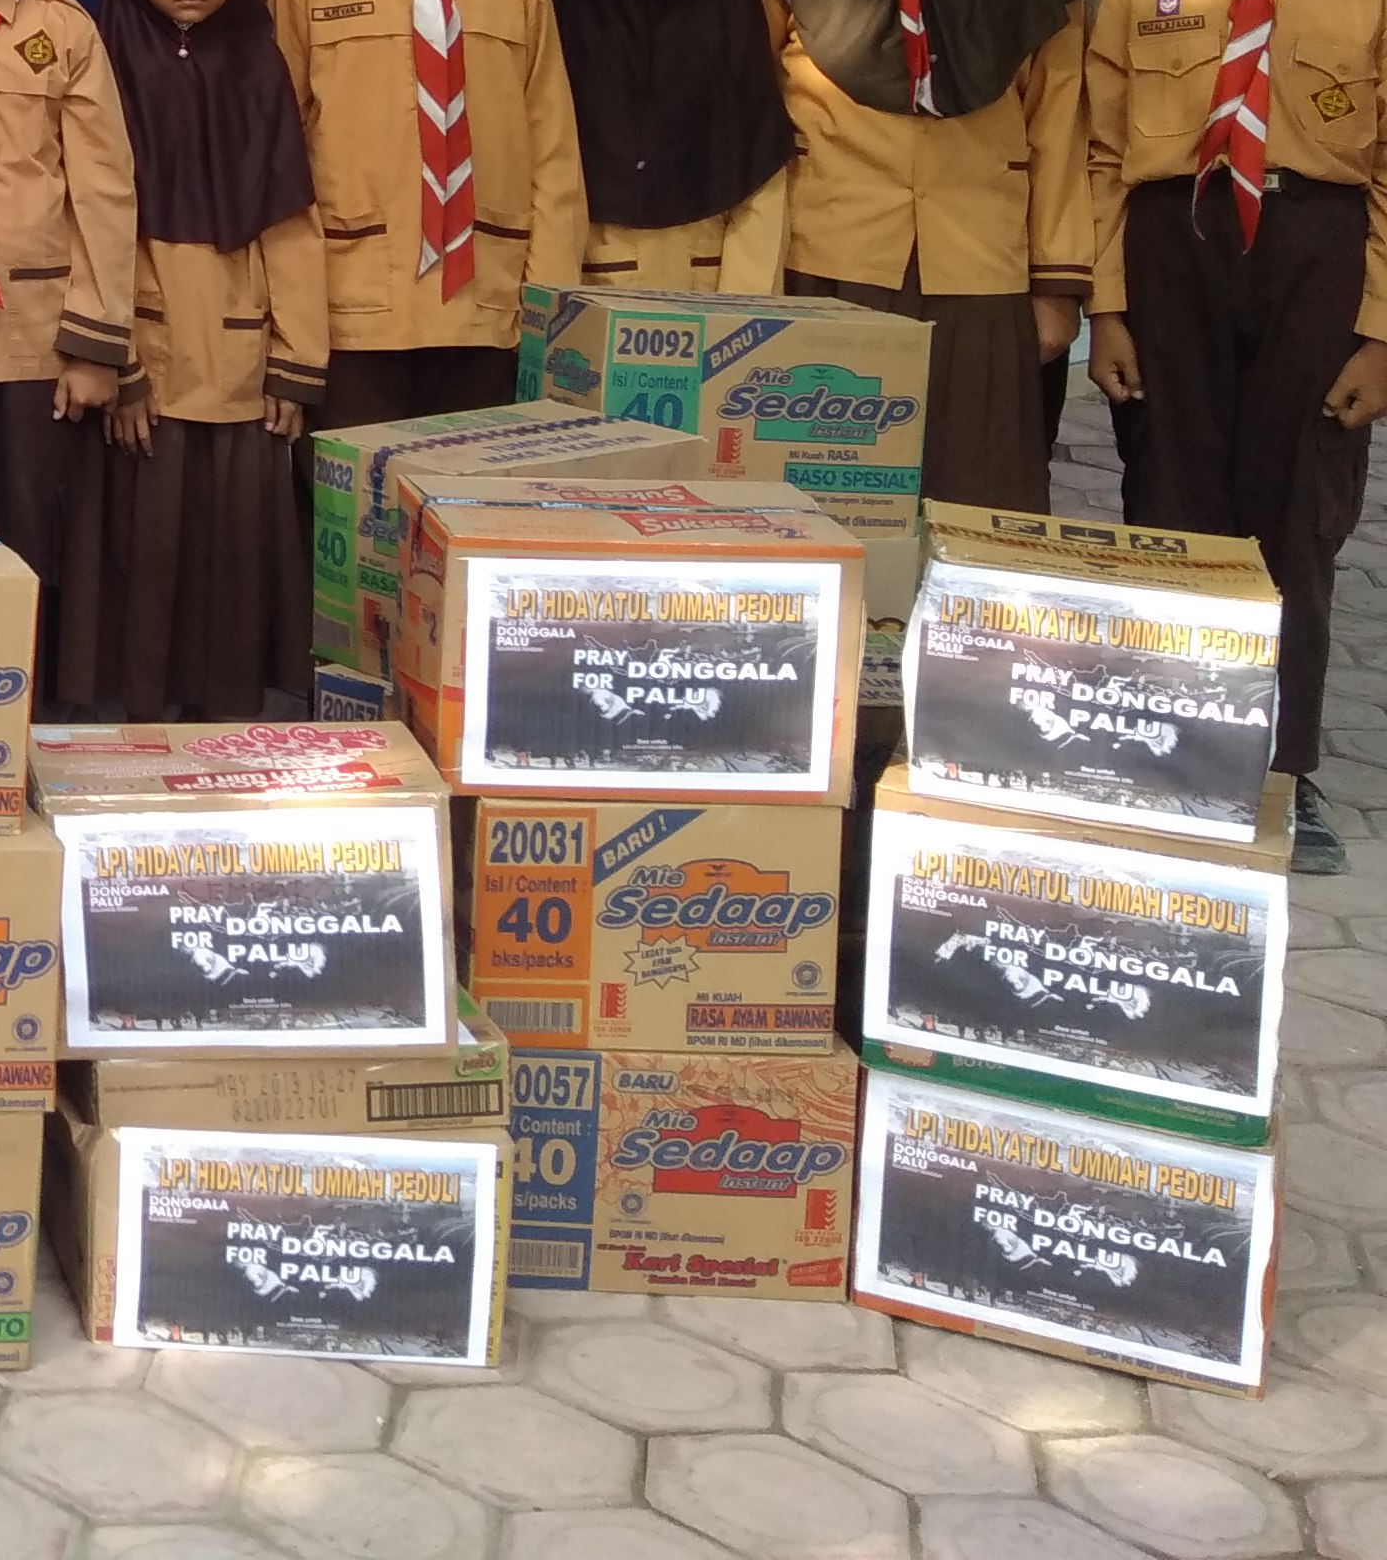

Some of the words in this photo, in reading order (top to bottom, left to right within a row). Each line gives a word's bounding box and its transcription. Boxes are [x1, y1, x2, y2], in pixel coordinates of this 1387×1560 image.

[618, 327, 695, 359] 20092
[709, 326, 753, 370] BARU
[746, 368, 793, 388] Mie
[716, 382, 920, 436] Sedaap
[787, 468, 836, 486] BASO
[827, 450, 859, 461] RASA
[95, 847, 129, 877] LPI
[131, 844, 244, 877] HIDAYATUL
[249, 842, 326, 875] UMMAH
[332, 840, 403, 873] PEDULI
[491, 820, 584, 864] 20031
[598, 882, 835, 933] Sedaap
[913, 847, 948, 882] LPI
[951, 854, 1072, 904] HIDAYATUL
[1078, 875, 1162, 920] UMMAH
[1169, 890, 1247, 935] PEDULI
[169, 906, 225, 923] PRAY
[226, 914, 403, 934] DONGGALA
[497, 898, 572, 943] 40
[170, 930, 213, 947] FOR
[227, 943, 310, 960] PALU
[985, 919, 1045, 946] PRAY
[1045, 942, 1241, 994] DONGGALA
[983, 943, 1029, 967] FOR
[1043, 968, 1134, 1001] PALU
[774, 1008, 832, 1028] BAWANG
[614, 1131, 845, 1181] Sedaap
